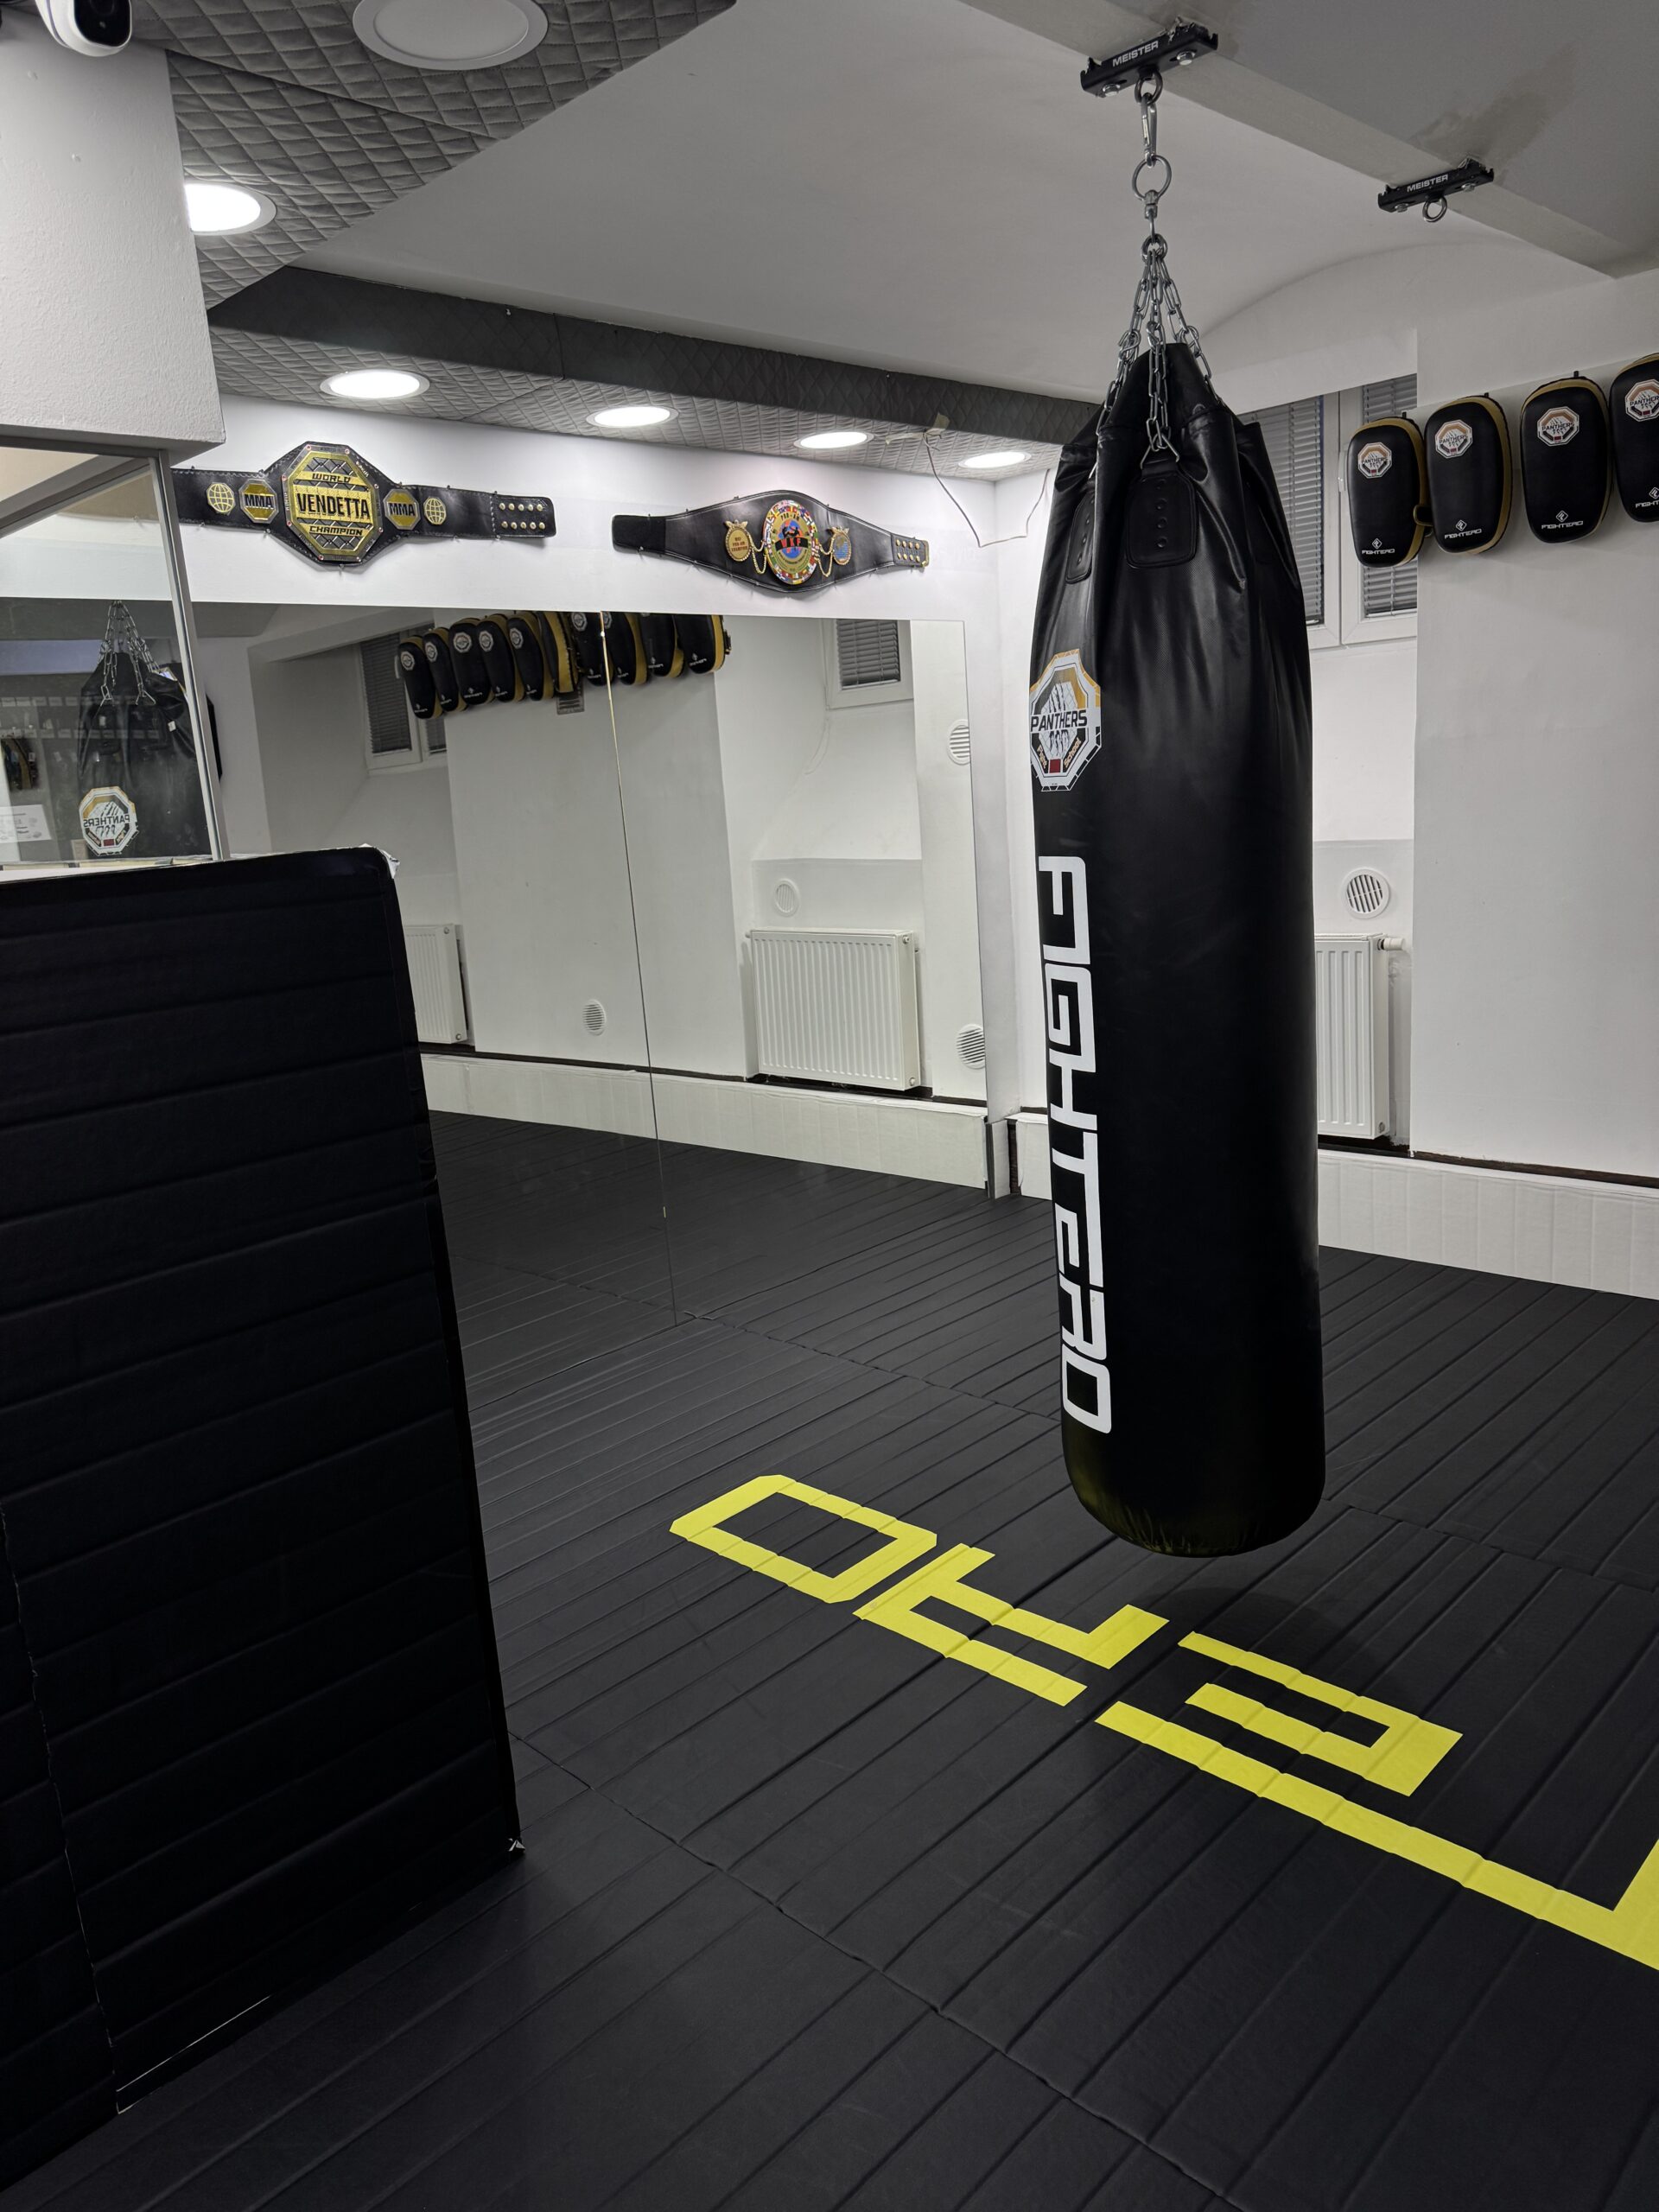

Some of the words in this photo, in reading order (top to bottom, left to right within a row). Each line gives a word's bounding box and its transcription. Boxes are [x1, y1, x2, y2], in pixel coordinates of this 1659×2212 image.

[1112, 40, 1159, 67] MEISTER
[1407, 174, 1449, 193] MEISTER
[312, 473, 351, 483] WORLD
[245, 494, 274, 509] MMA
[296, 493, 371, 519] VENDETTA
[389, 502, 416, 517] MMA
[309, 525, 363, 536] CHAMPION
[1030, 709, 1088, 732] PANTHERS
[1038, 855, 1112, 1434] FIGHTERO
